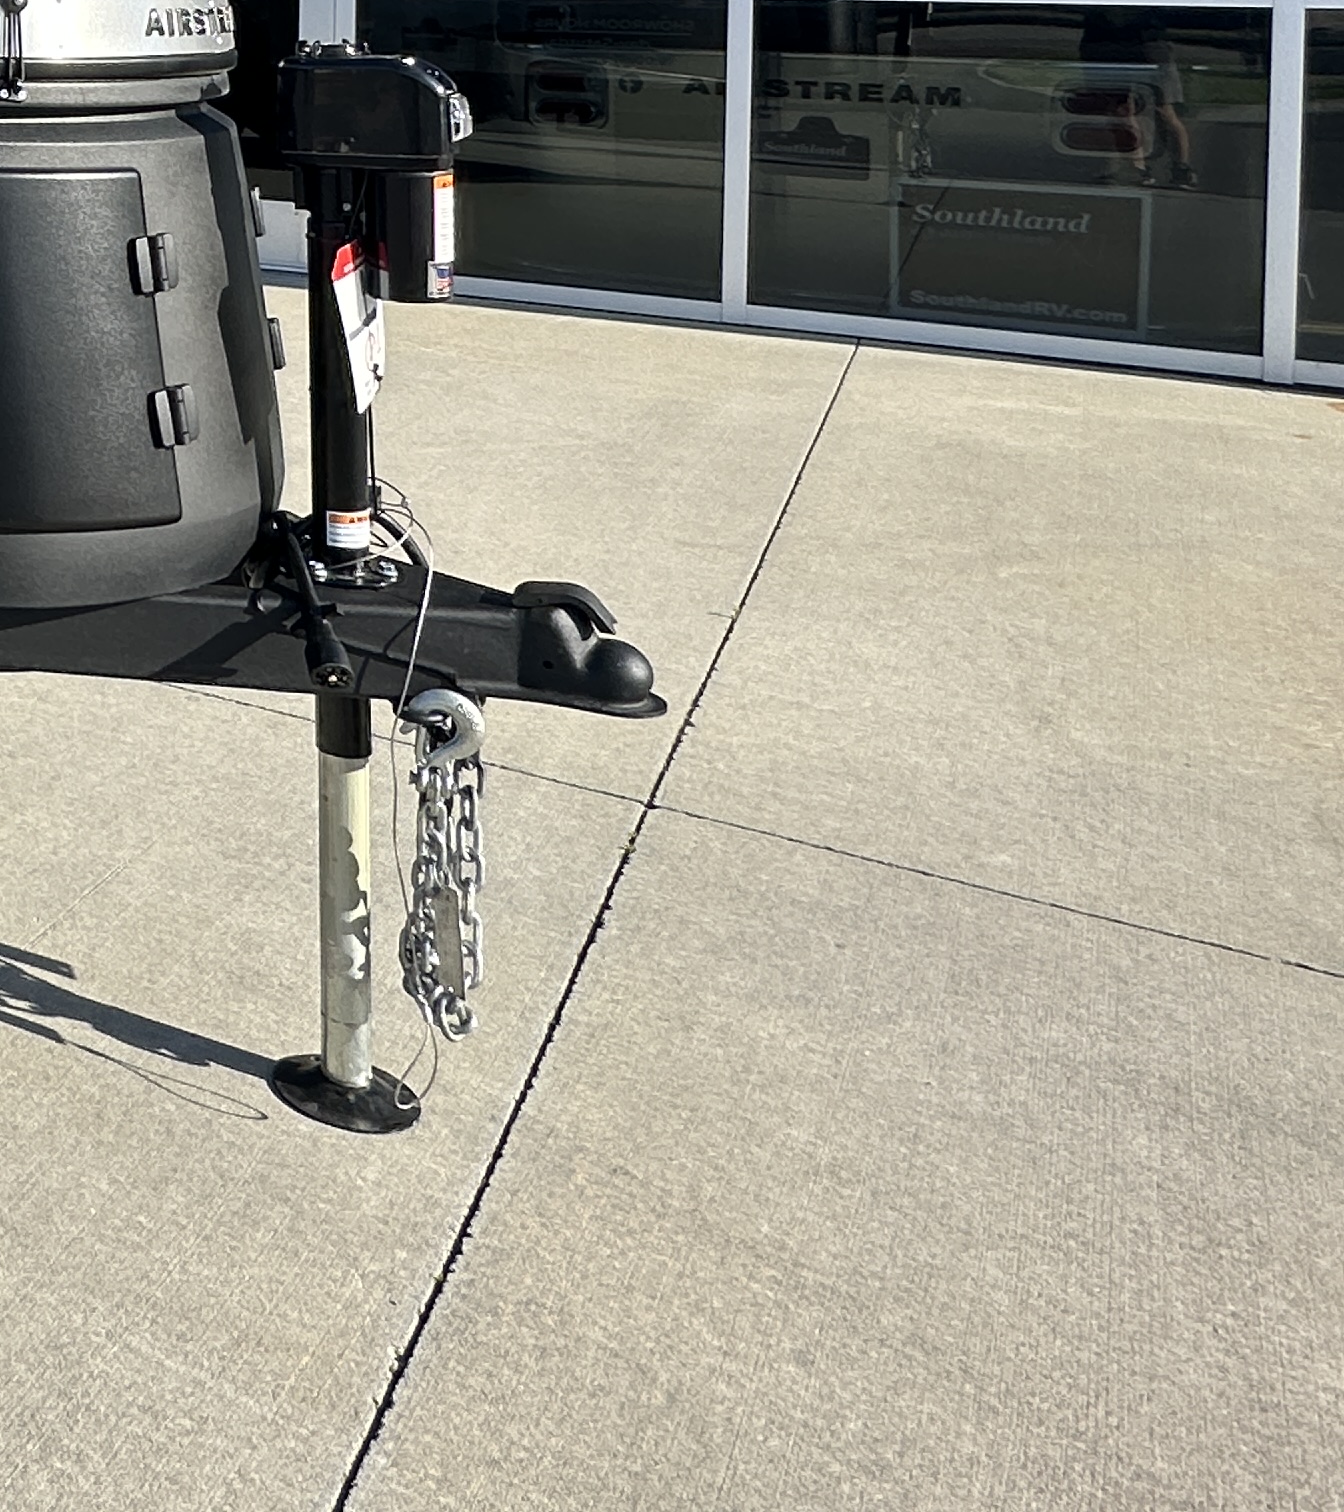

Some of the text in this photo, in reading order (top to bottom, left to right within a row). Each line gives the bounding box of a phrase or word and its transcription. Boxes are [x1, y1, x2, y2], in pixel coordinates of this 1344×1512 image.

[682, 78, 962, 107] AISTREAM
[762, 141, 847, 158] Southland
[912, 203, 1092, 234] Southland
[909, 290, 1129, 323] SouthlandRV.com
